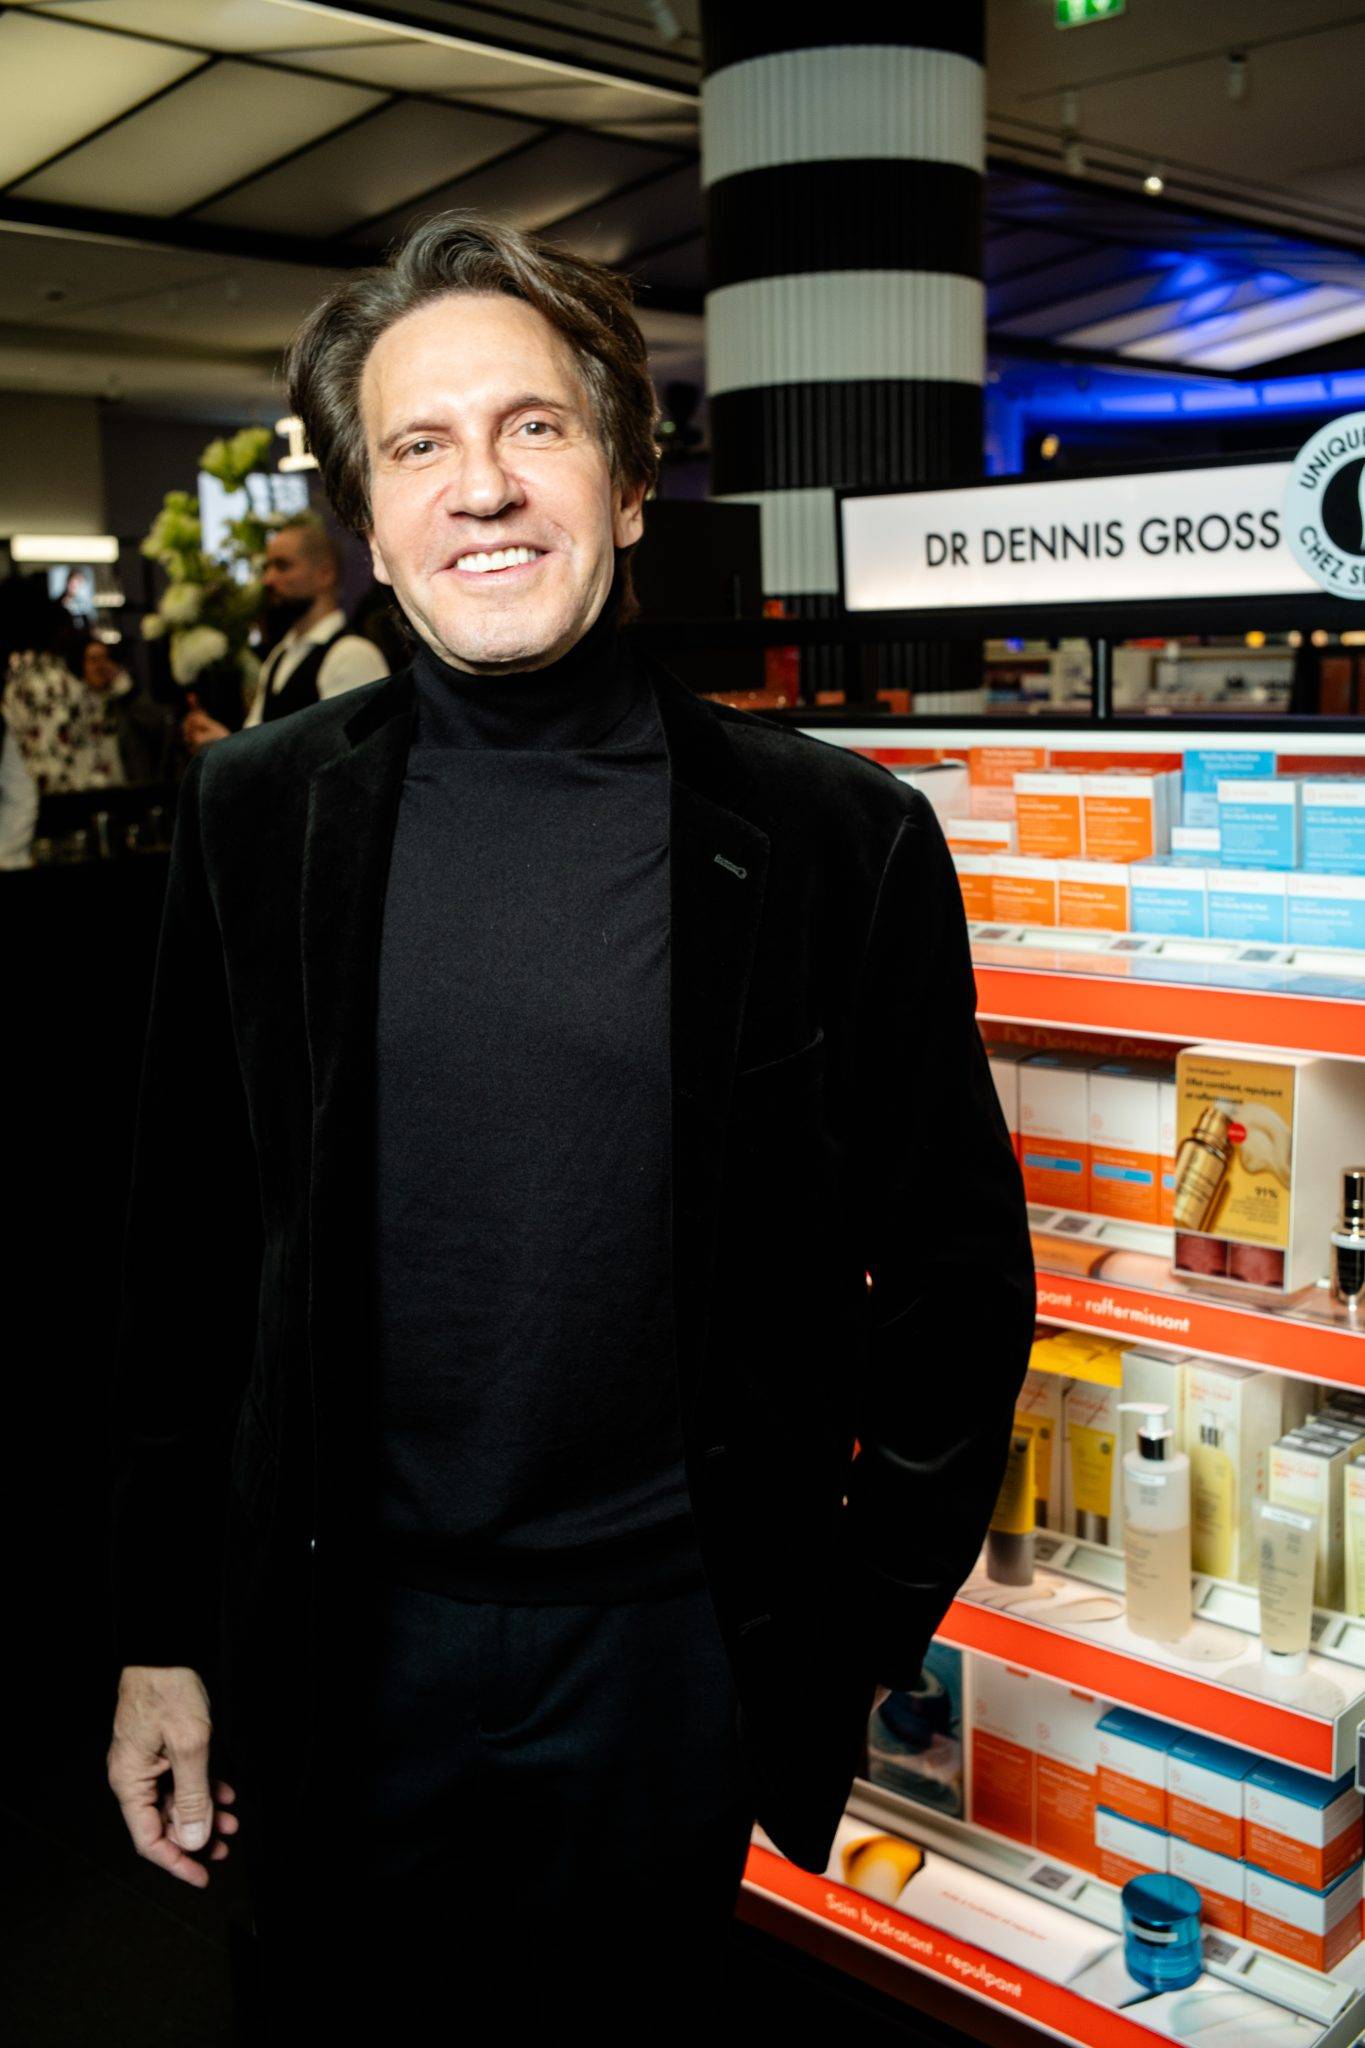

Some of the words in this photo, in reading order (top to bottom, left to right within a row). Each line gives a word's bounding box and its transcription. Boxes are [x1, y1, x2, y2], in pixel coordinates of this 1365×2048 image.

[926, 533, 969, 568] DR
[983, 521, 1124, 563] DENNIS
[1139, 509, 1281, 556] GROSS
[1299, 525, 1345, 580] CHEZ
[1085, 1297, 1190, 1332] raffermissant
[825, 1892, 859, 1919] Soin
[860, 1905, 935, 1957] hydratant
[944, 1952, 1023, 1999] repulpant
